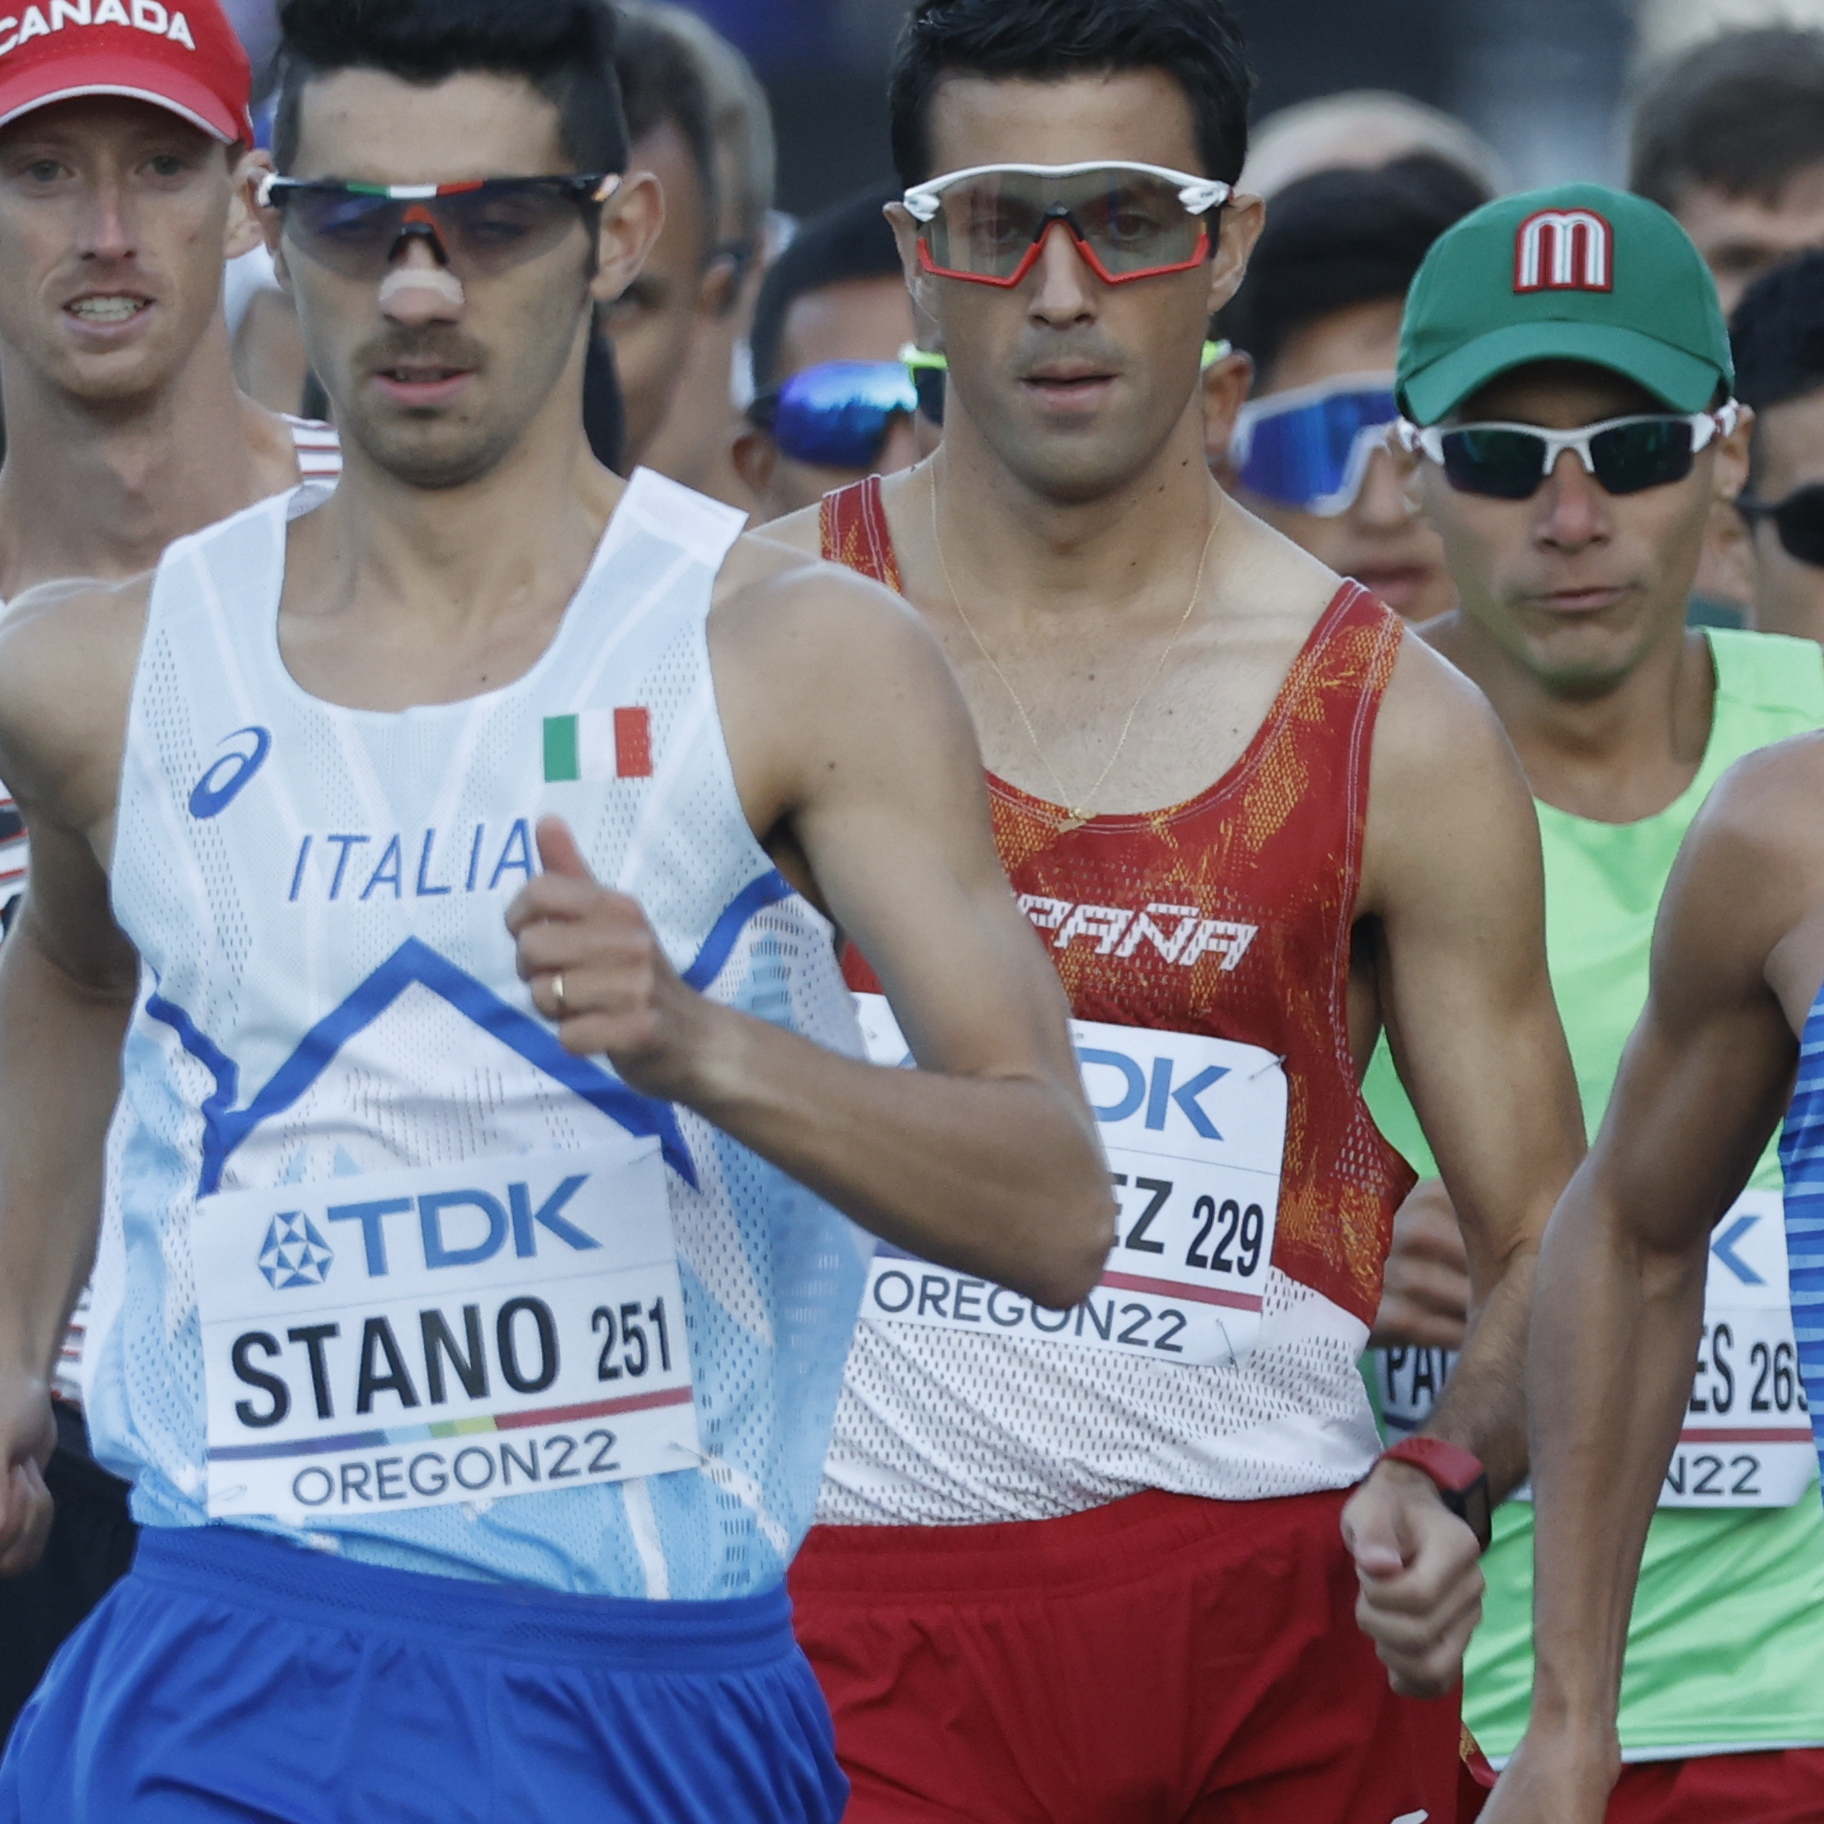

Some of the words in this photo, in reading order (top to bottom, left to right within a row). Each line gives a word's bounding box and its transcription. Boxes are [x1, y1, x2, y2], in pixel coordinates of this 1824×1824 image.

[0, 0, 196, 56] CANADA
[288, 816, 540, 902] ITALIA
[328, 1173, 603, 1279] TDK
[1185, 1194, 1265, 1278] 229
[872, 1269, 1189, 1354] OREGON22
[230, 1295, 560, 1430] STANO
[590, 1295, 674, 1383] 251
[291, 1428, 621, 1508] OREGON22
